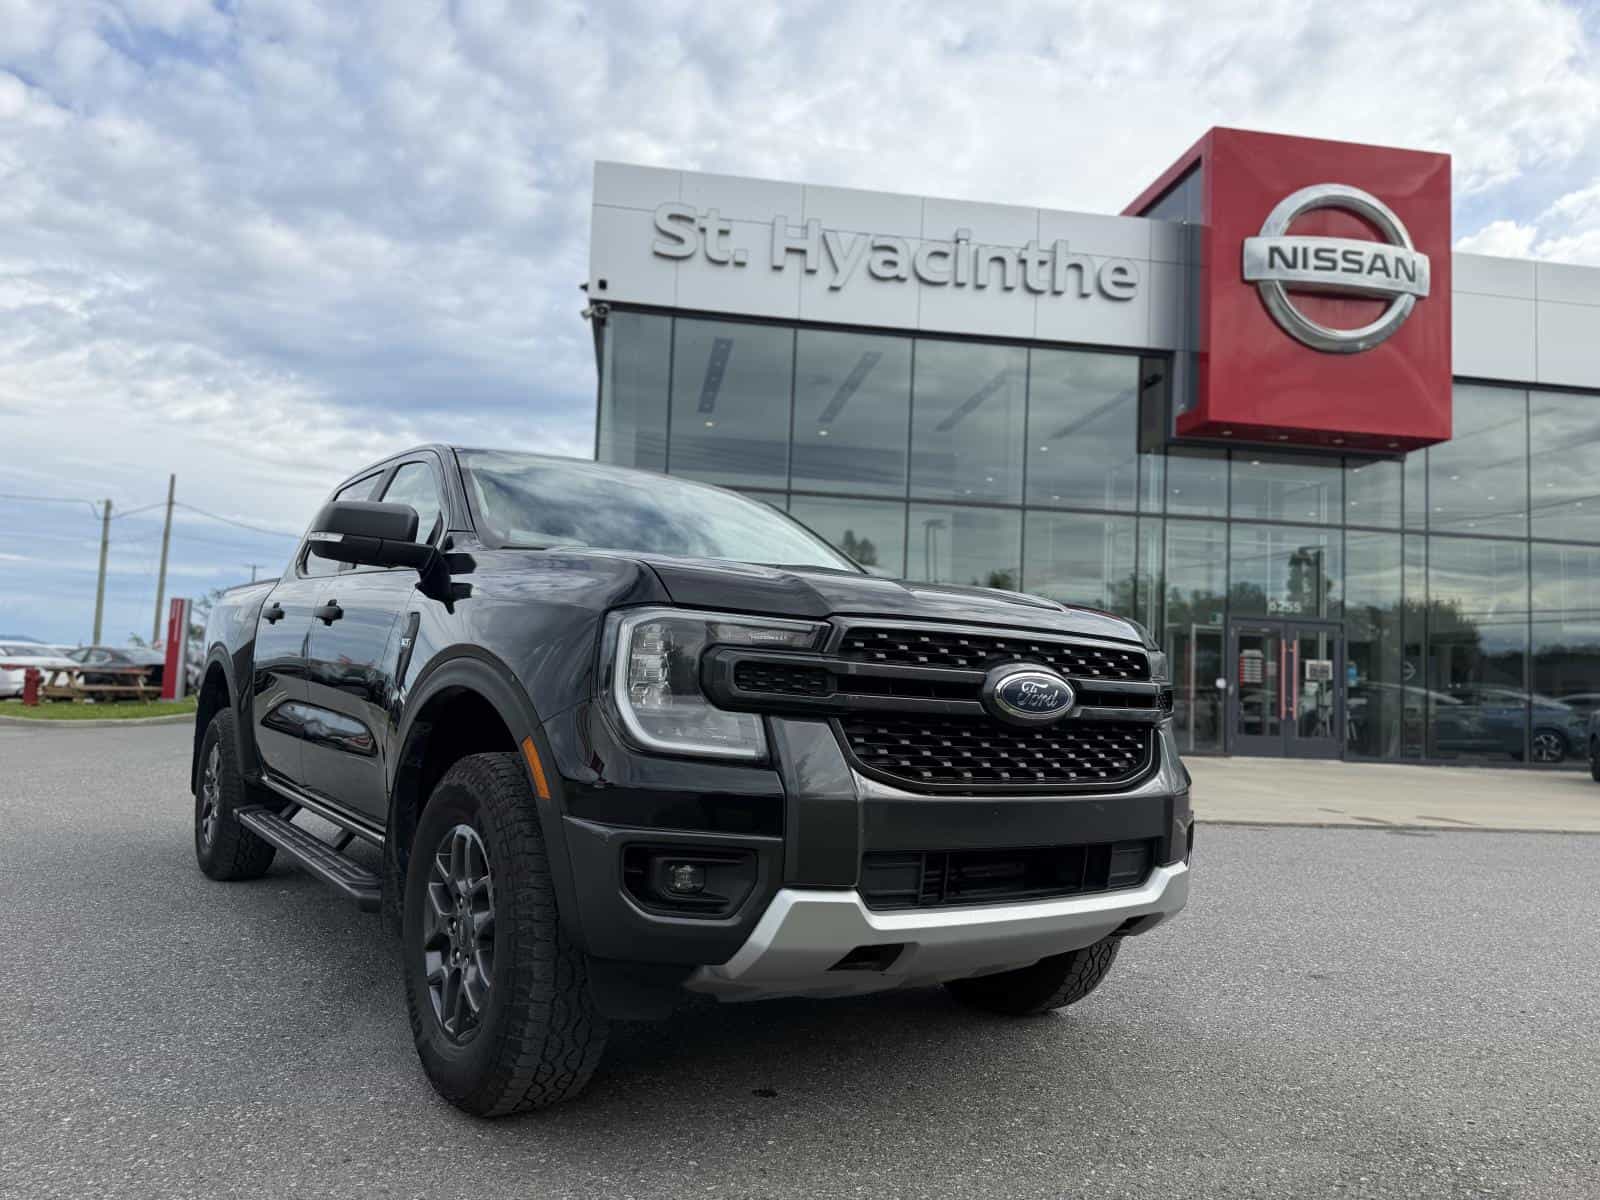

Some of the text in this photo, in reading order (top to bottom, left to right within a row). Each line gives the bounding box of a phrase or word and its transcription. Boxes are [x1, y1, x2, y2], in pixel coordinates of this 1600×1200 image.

[652, 201, 1141, 302] St. Hyacinthe
[1268, 246, 1416, 283] NISSAN
[1017, 681, 1060, 708] Ford
